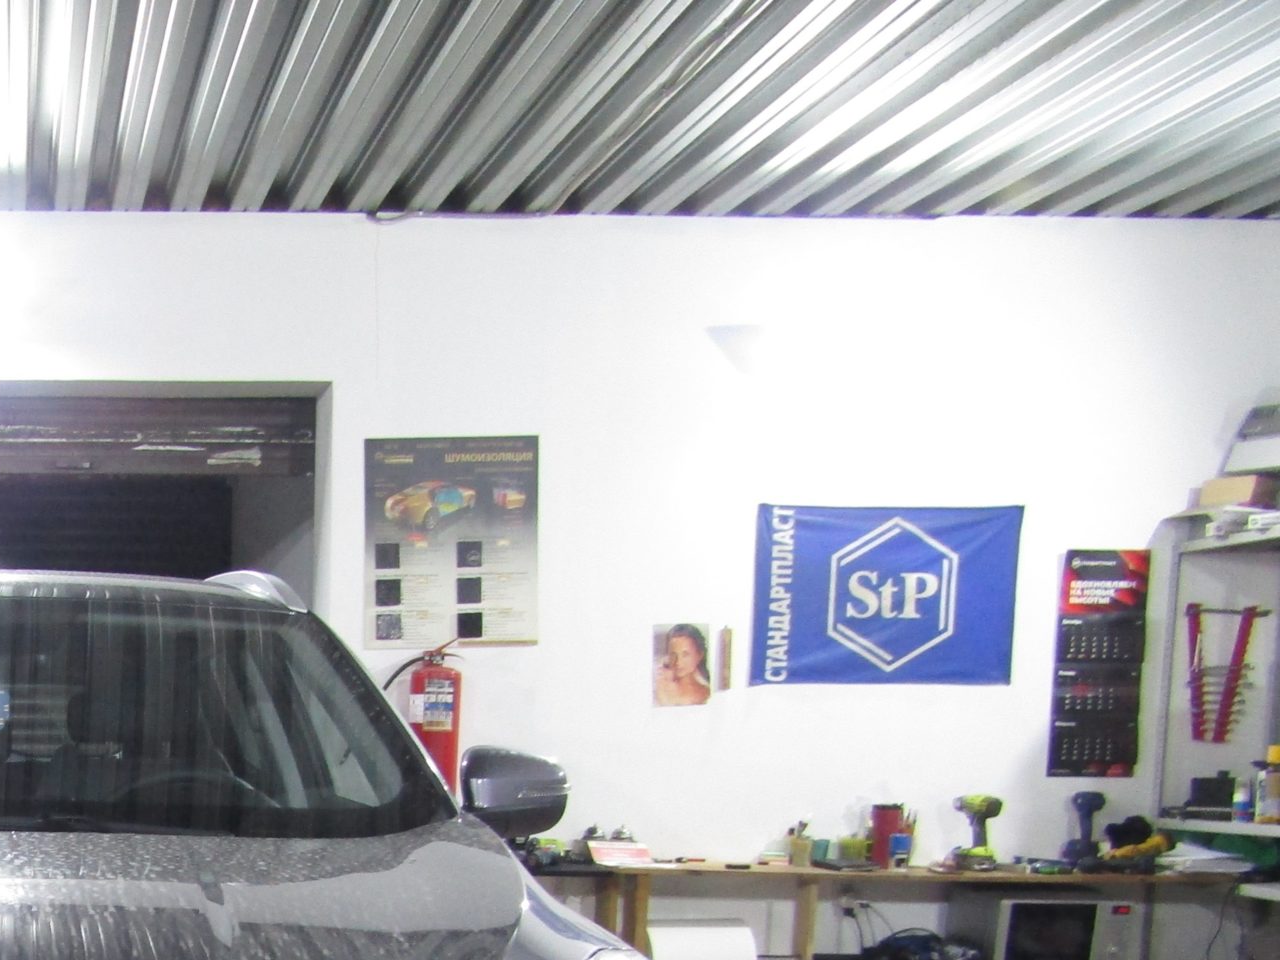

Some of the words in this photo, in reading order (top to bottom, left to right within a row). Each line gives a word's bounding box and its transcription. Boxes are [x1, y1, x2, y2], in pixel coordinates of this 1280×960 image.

[444, 452, 533, 463] ШУМОИЗОЛЯЦИЯ
[764, 506, 797, 682] СТАНДАРТПЛАСТ
[845, 571, 939, 619] StP
